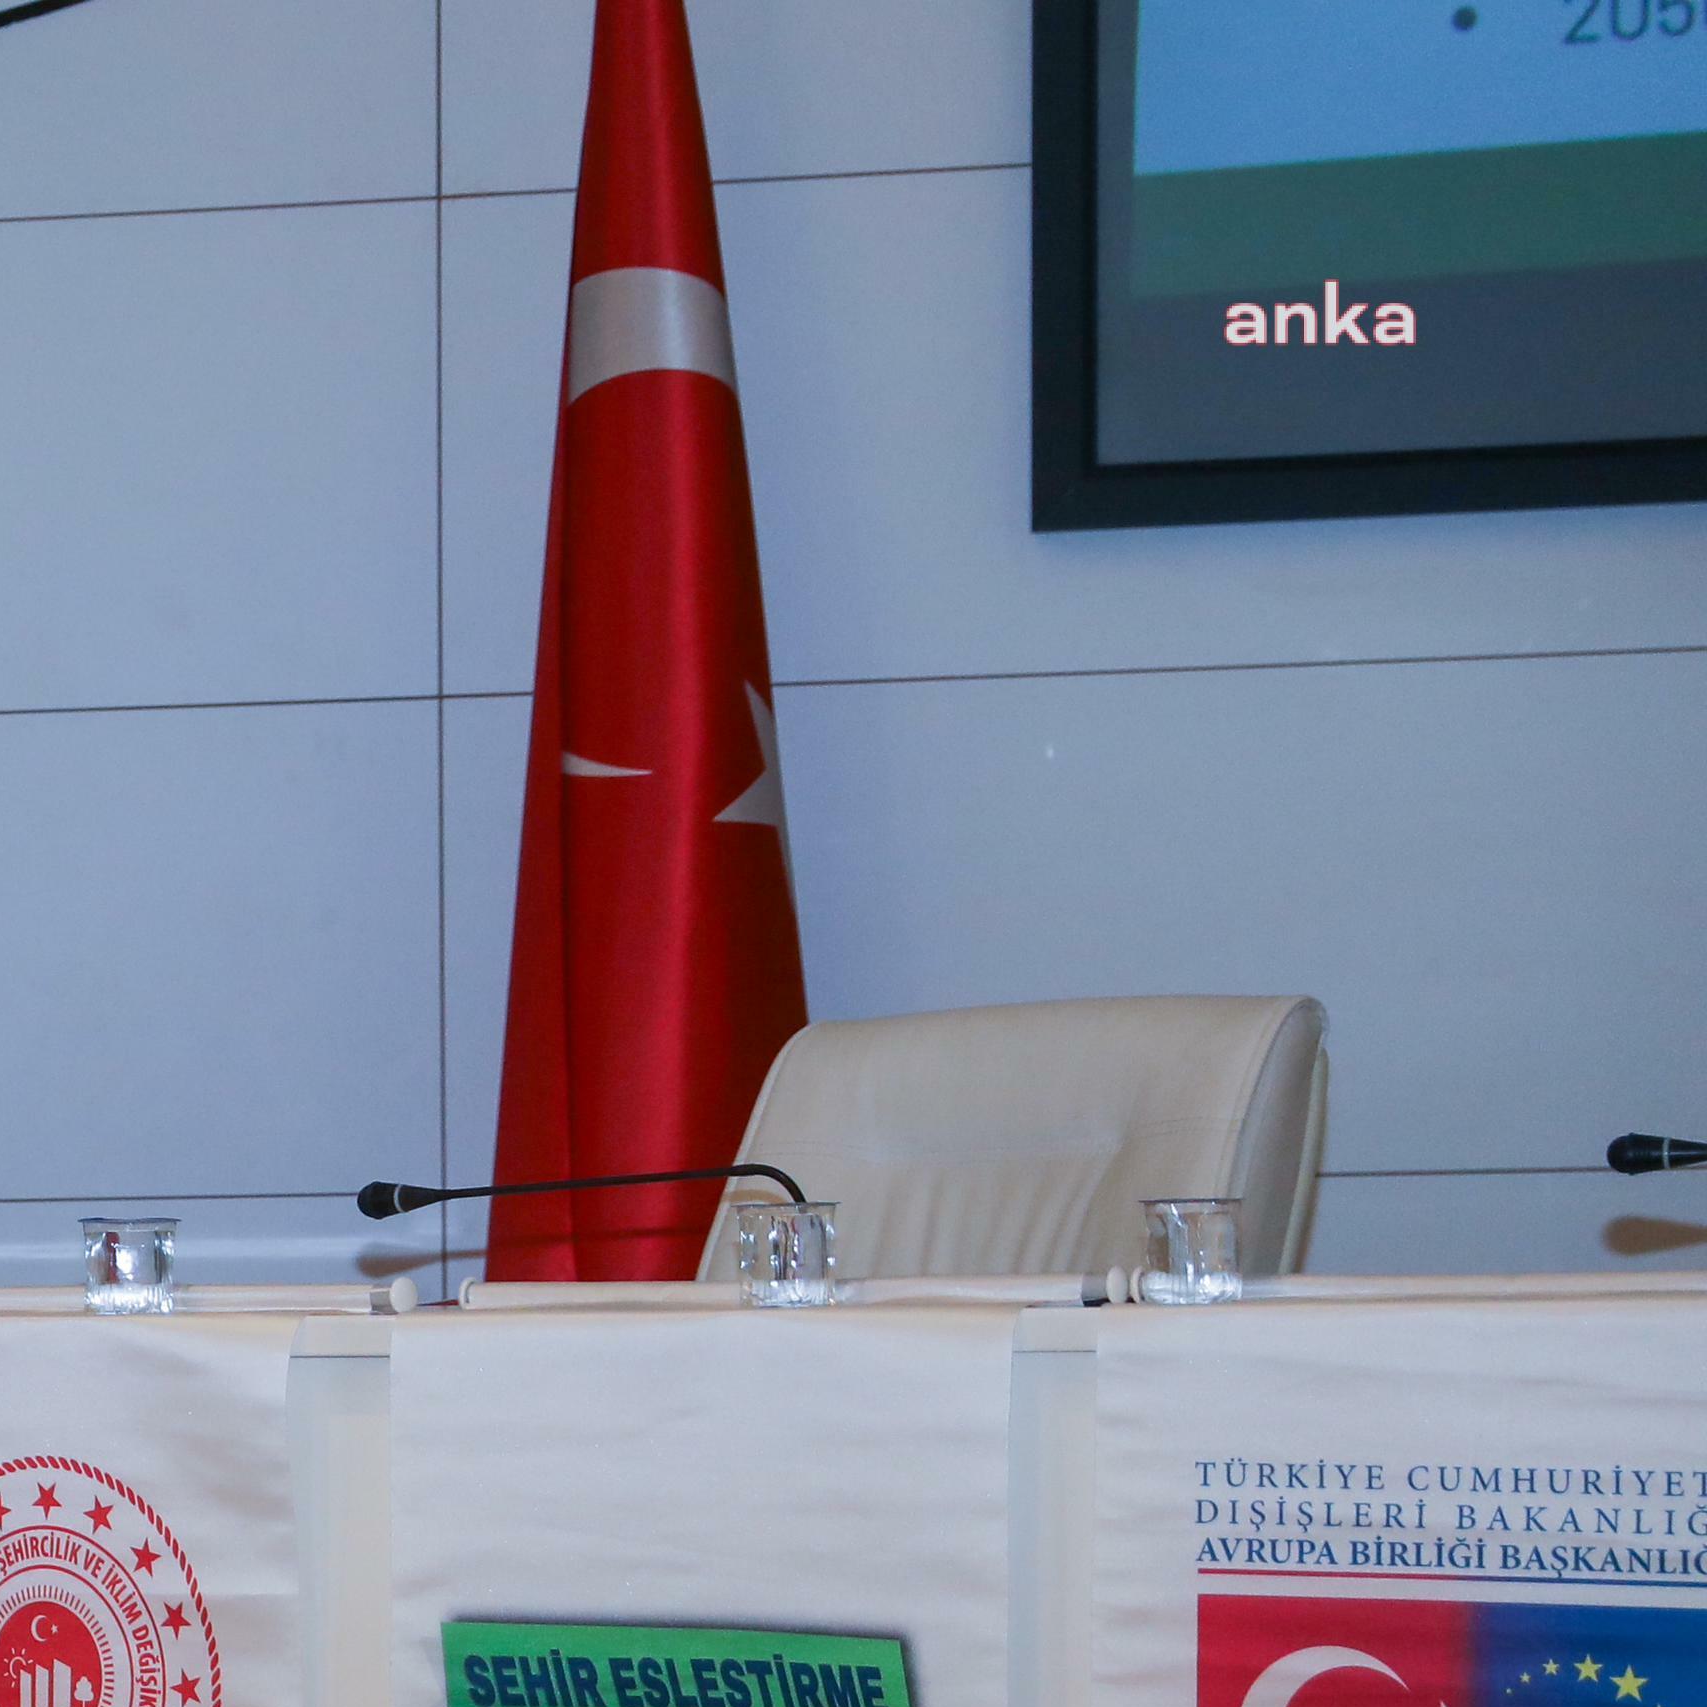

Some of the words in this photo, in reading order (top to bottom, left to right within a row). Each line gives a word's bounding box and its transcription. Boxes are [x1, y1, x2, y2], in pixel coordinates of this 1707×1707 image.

[1563, 0, 1707, 44] 205
[1195, 1458, 1384, 1490] TÜRKİYE
[1196, 1498, 1426, 1532] DIŞİŞLERİ
[83, 1550, 105, 1578] VE
[1196, 1540, 1337, 1566] AVRUPA
[1350, 1536, 1485, 1573] BİRLİĞİ
